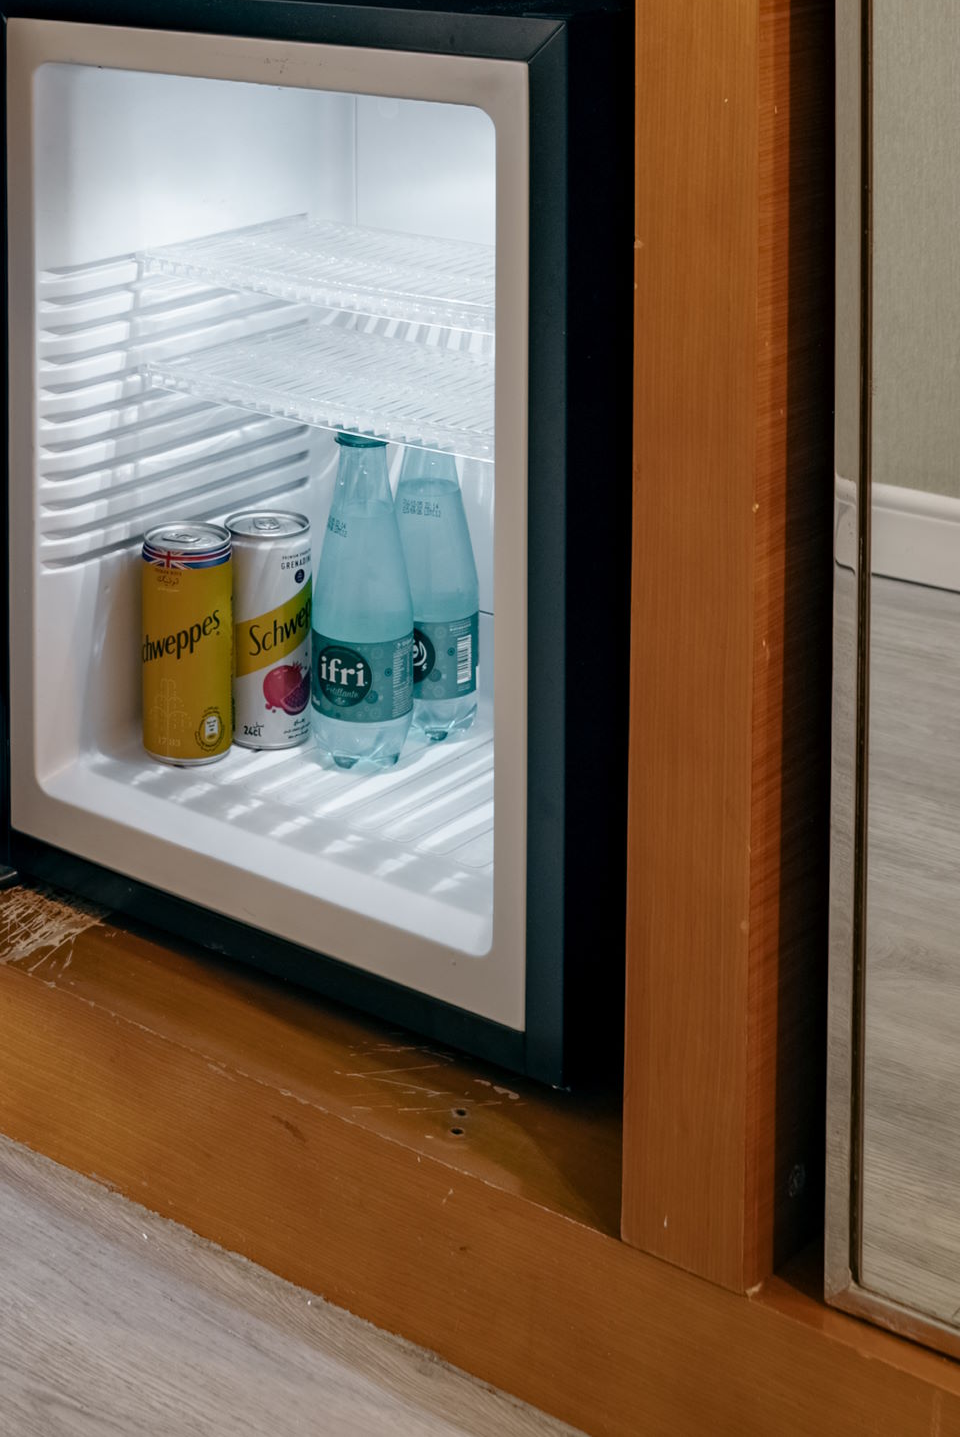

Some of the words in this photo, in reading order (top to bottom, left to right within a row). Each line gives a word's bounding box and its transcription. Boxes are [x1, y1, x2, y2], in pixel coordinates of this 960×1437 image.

[142, 609, 220, 663] chweppes
[249, 598, 312, 656] Schwep
[321, 655, 365, 687] ifri
